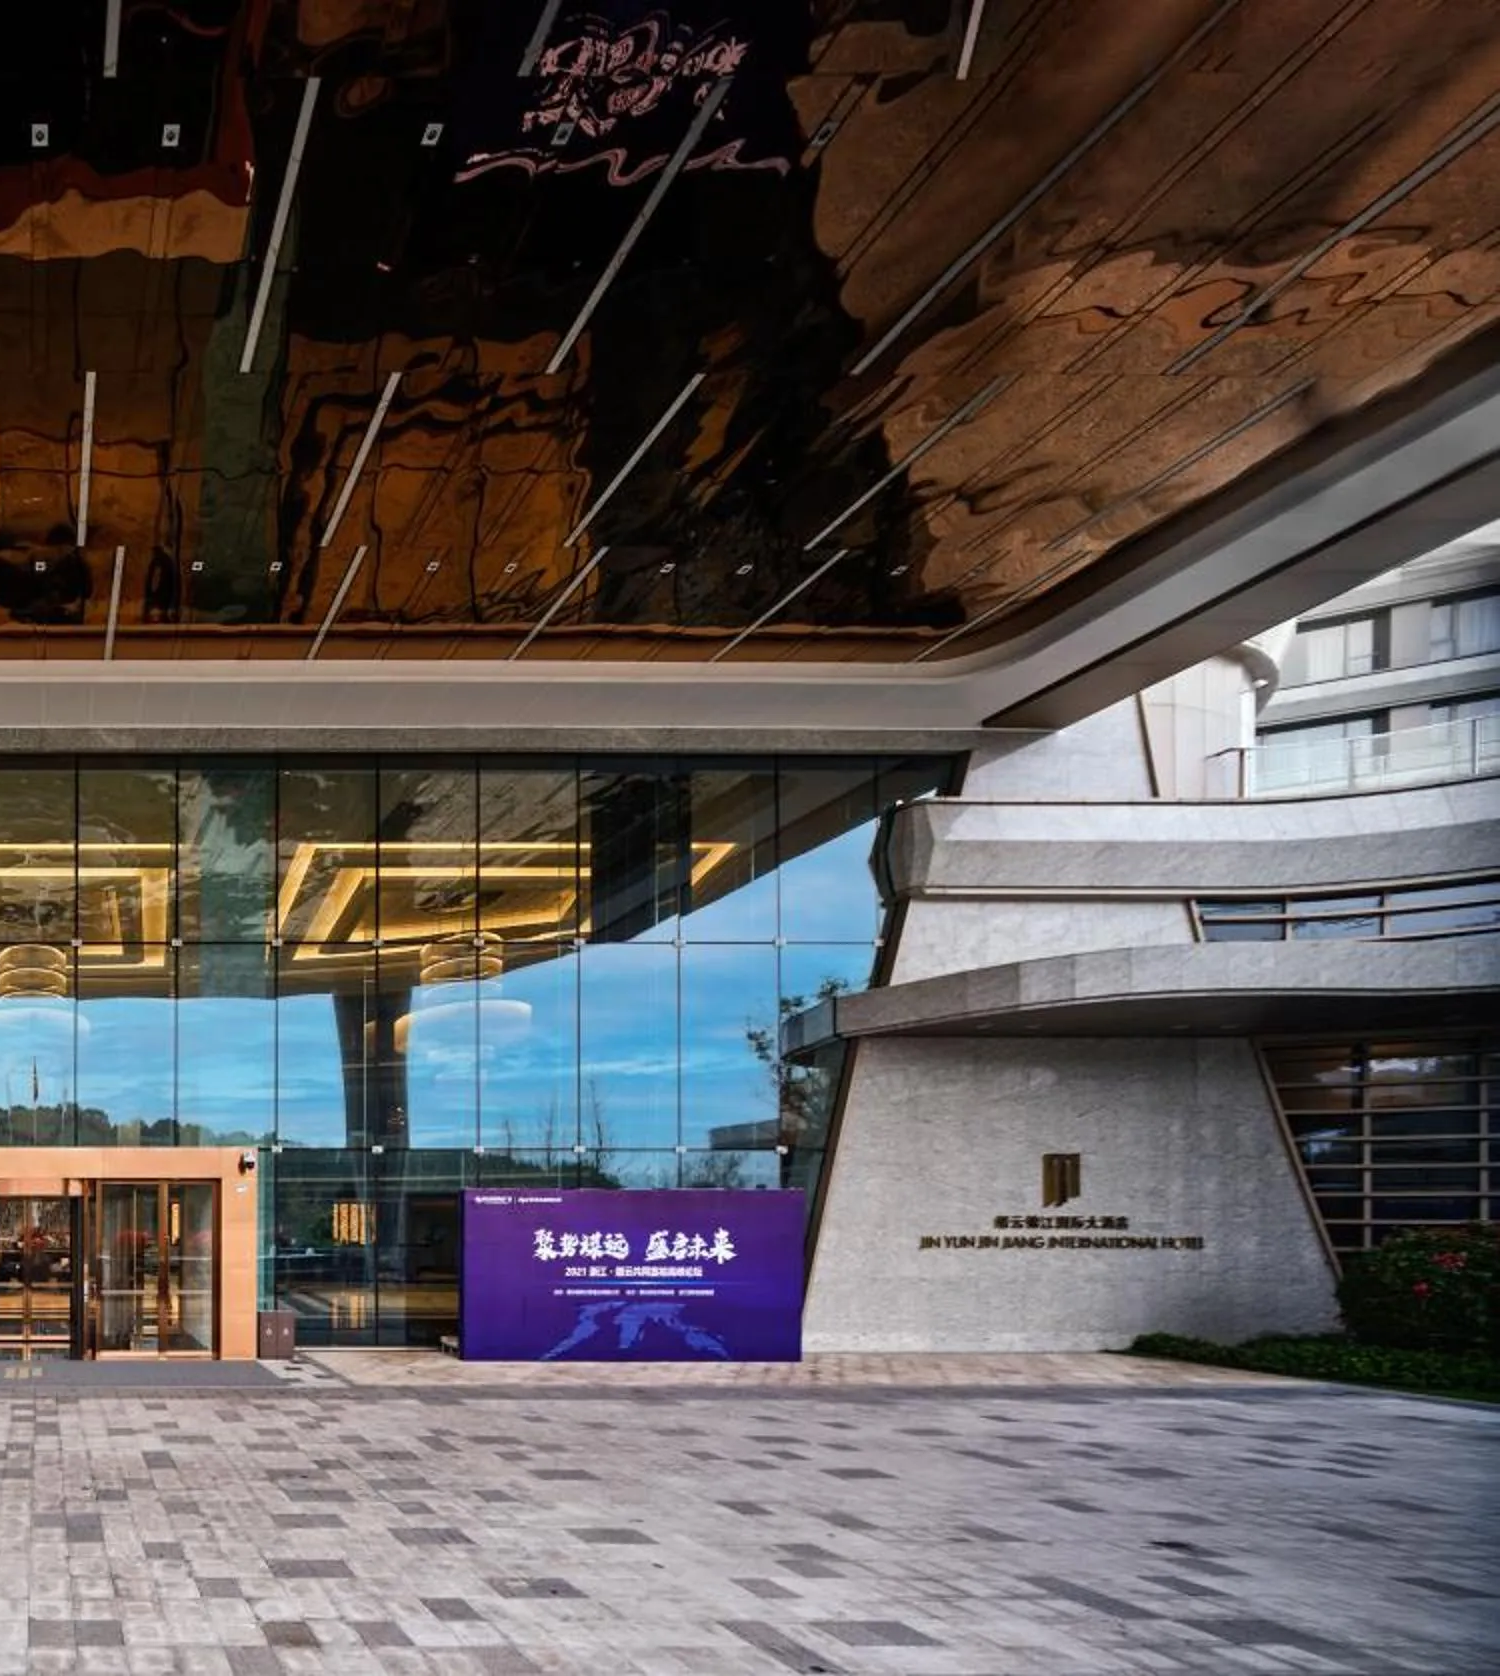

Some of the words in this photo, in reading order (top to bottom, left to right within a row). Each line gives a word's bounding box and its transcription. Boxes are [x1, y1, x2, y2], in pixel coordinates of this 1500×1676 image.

[918, 1235, 941, 1249] JIN
[943, 1235, 975, 1249] YUN
[976, 1235, 999, 1249] JIN
[1000, 1236, 1045, 1249] JIANG
[1047, 1236, 1158, 1249] INTERNATIONAL
[1161, 1236, 1204, 1250] HOTEL
[564, 1266, 587, 1277] 2021
